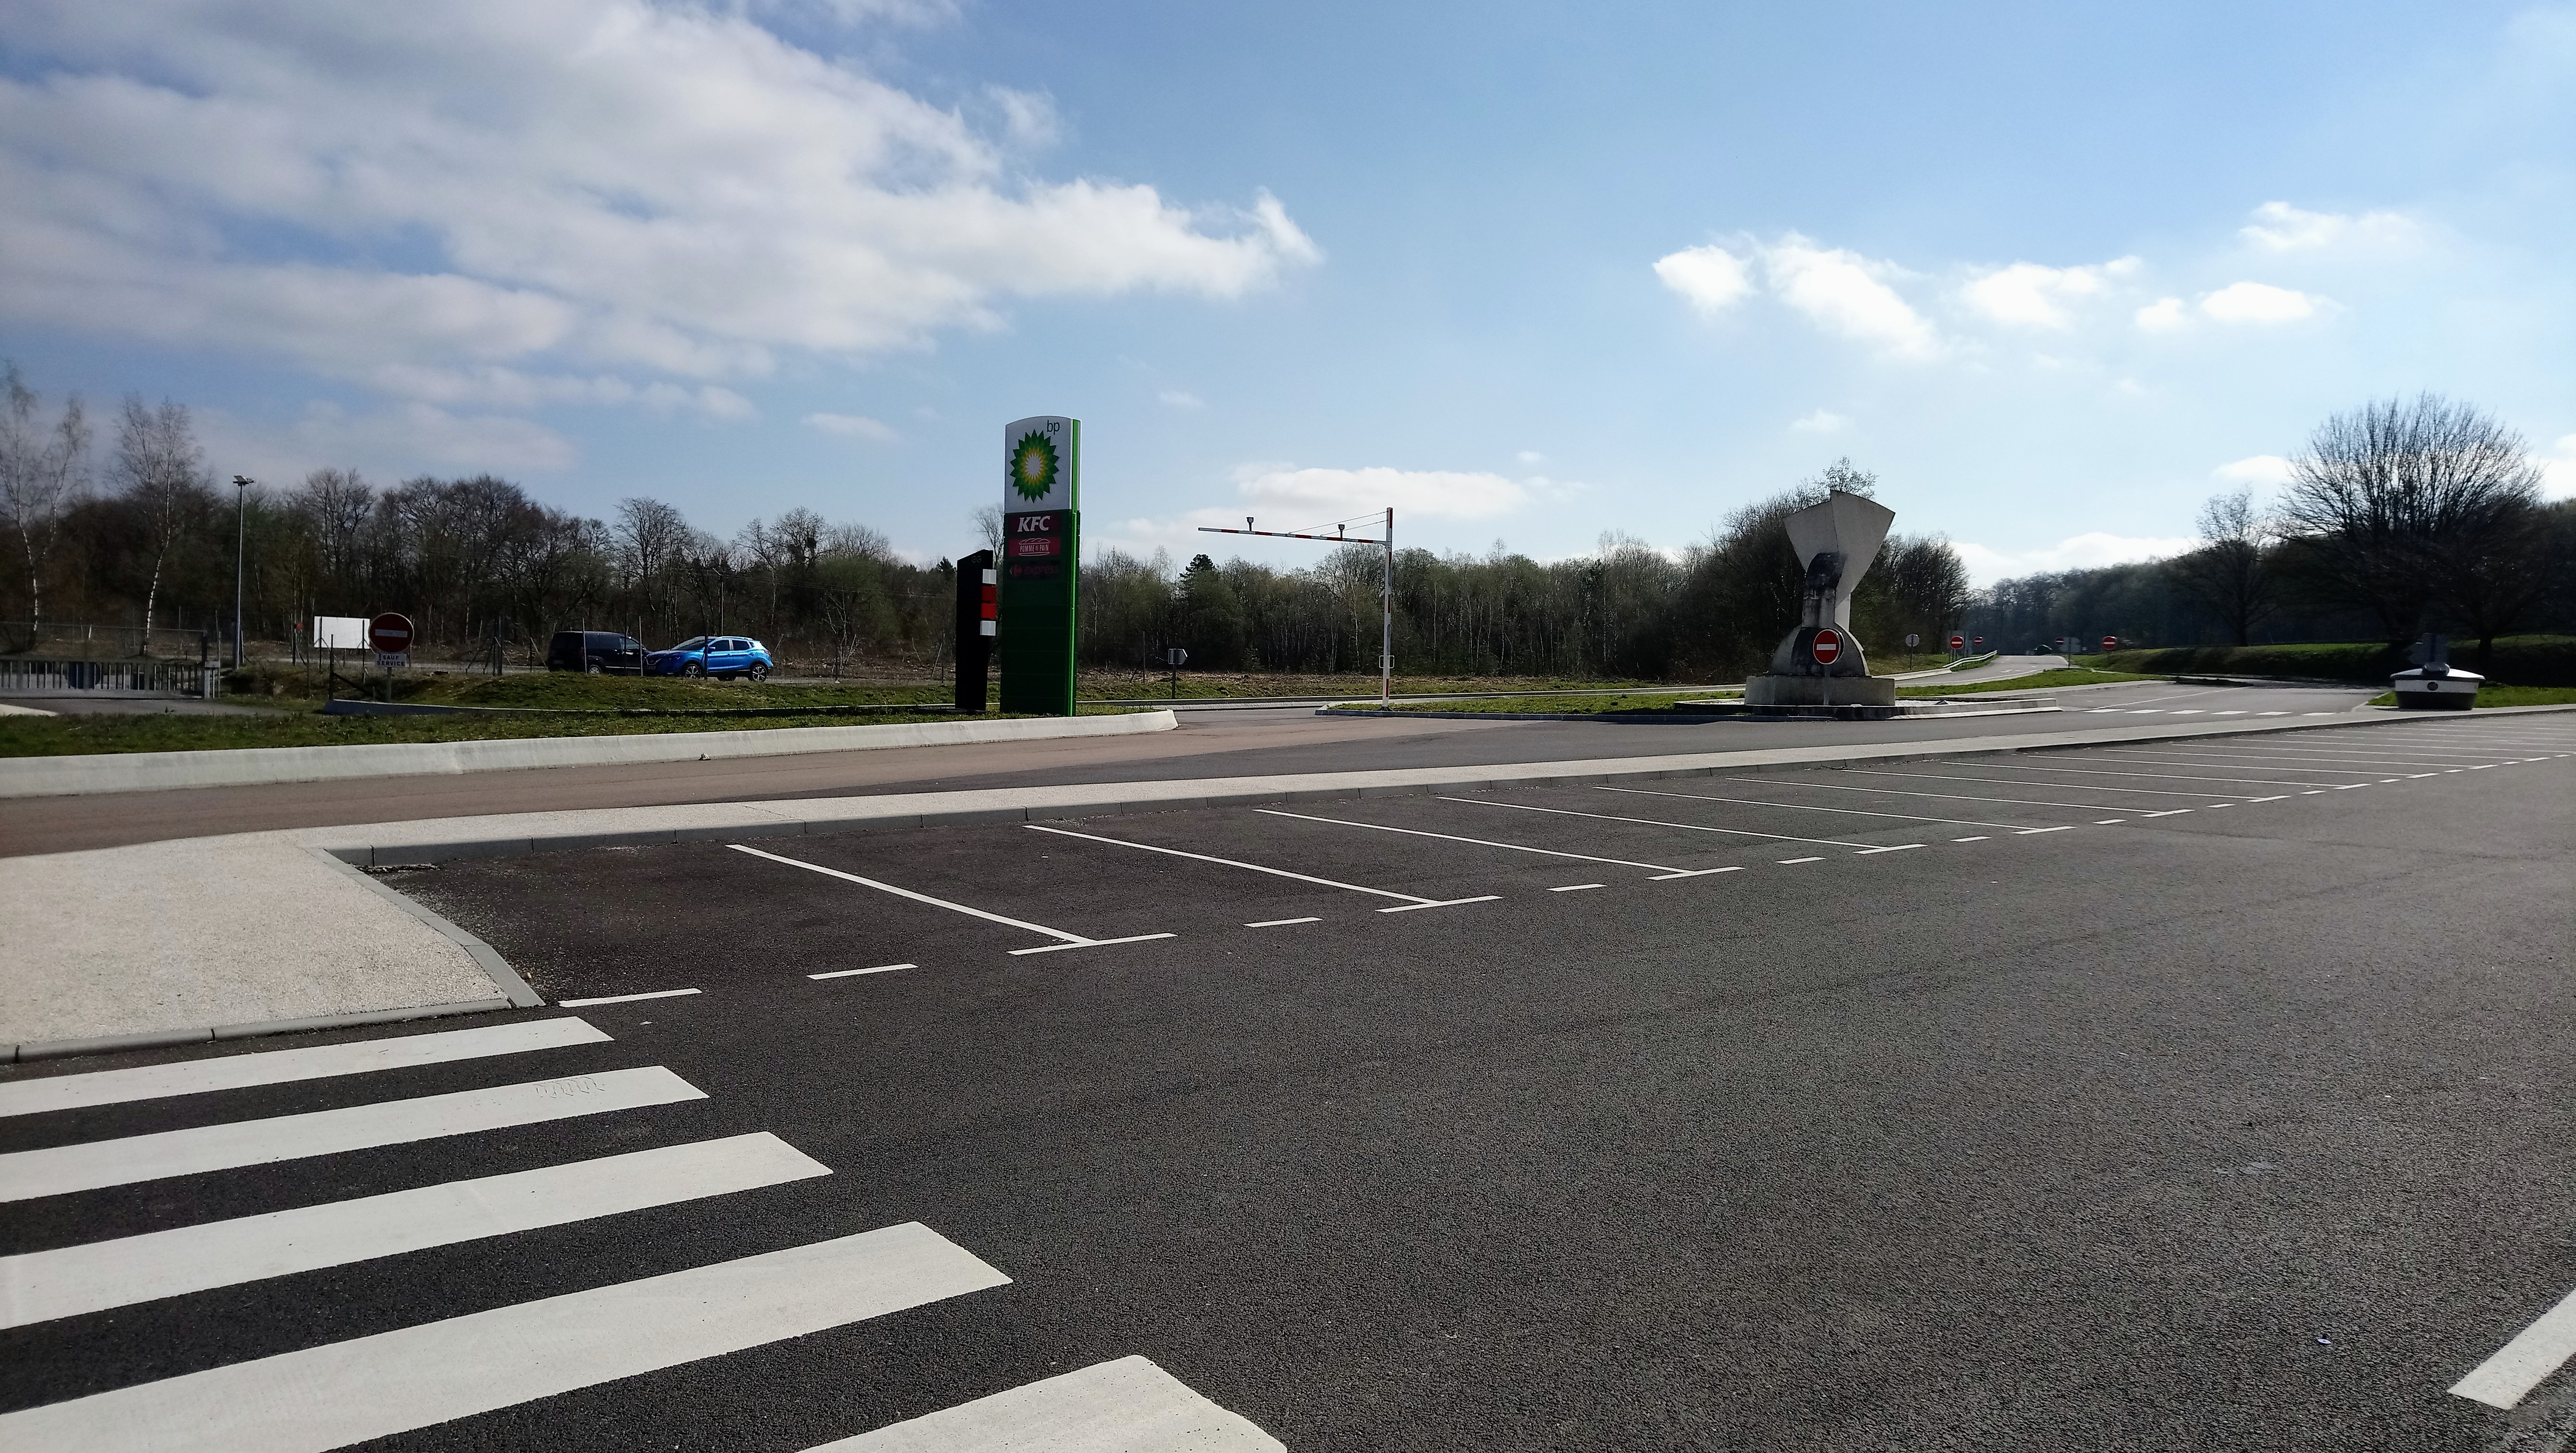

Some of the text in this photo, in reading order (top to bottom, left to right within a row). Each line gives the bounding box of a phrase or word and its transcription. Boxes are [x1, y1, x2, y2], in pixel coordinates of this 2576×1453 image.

[1047, 420, 1060, 435] bp
[1017, 516, 1050, 532] KFC
[1024, 565, 1059, 576] express
